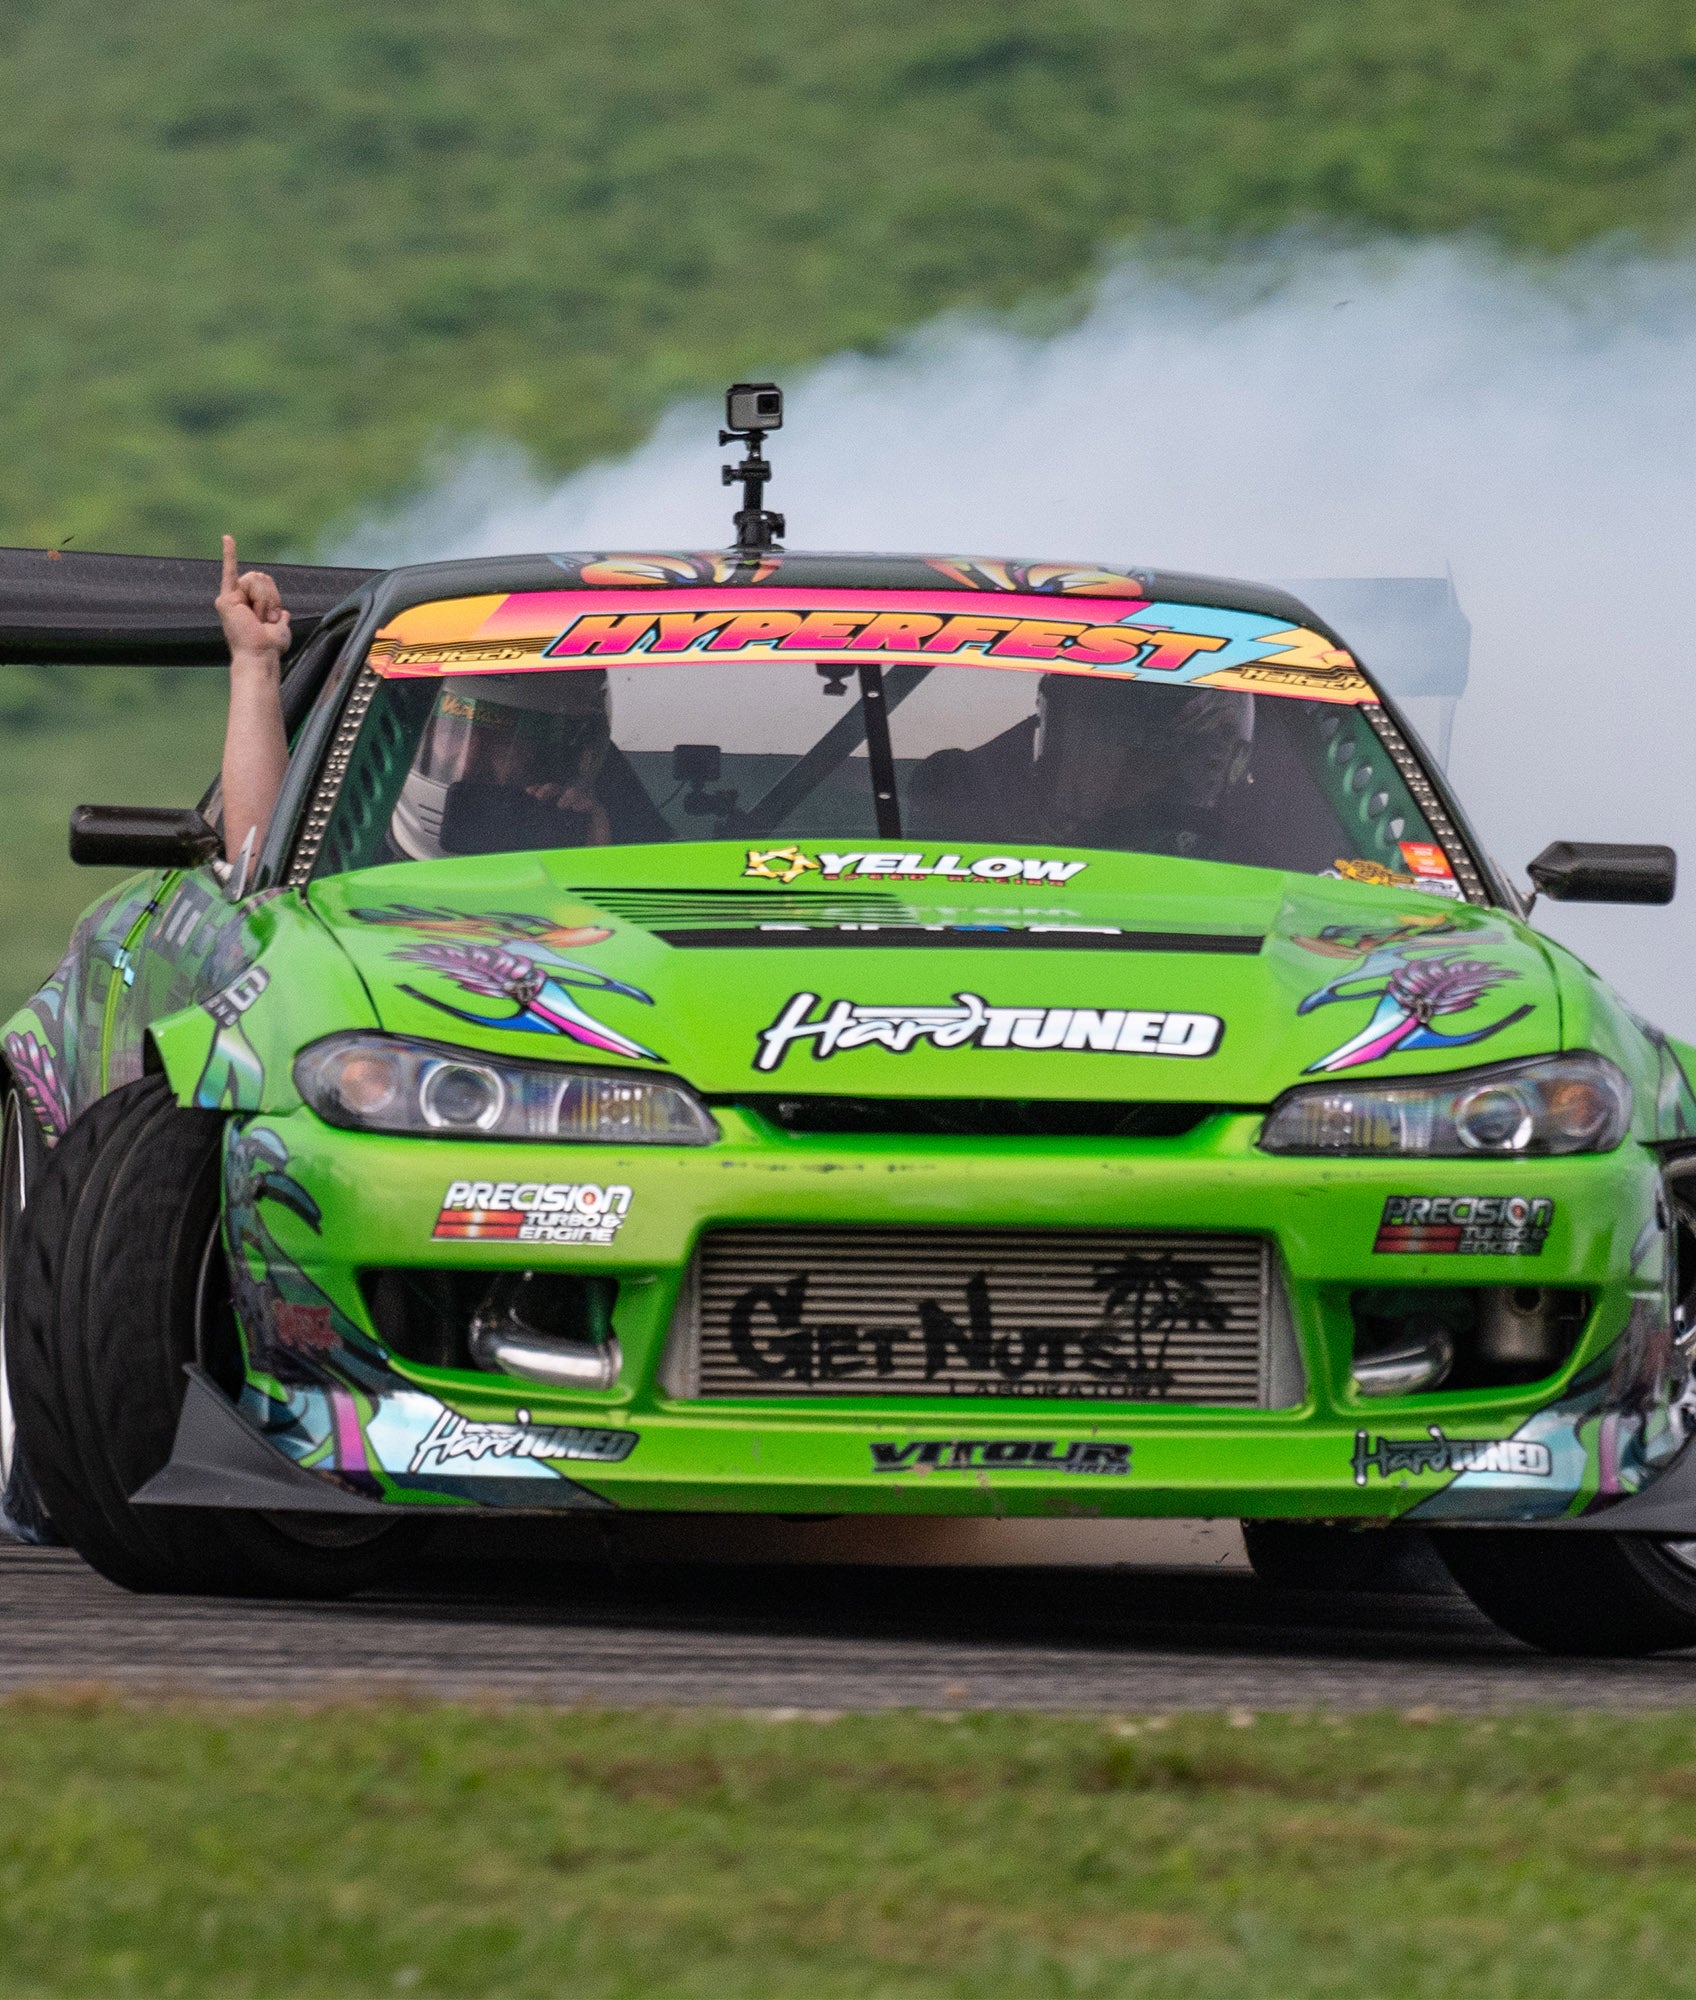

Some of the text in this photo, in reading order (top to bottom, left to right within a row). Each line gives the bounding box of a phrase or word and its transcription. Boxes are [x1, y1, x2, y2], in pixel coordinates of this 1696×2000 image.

[543, 610, 1232, 671] HYPERFEST
[394, 649, 524, 664] Haltech
[1241, 669, 1367, 690] Haltech
[818, 852, 1088, 881] YELLOW
[526, 1212, 601, 1227] TURBO
